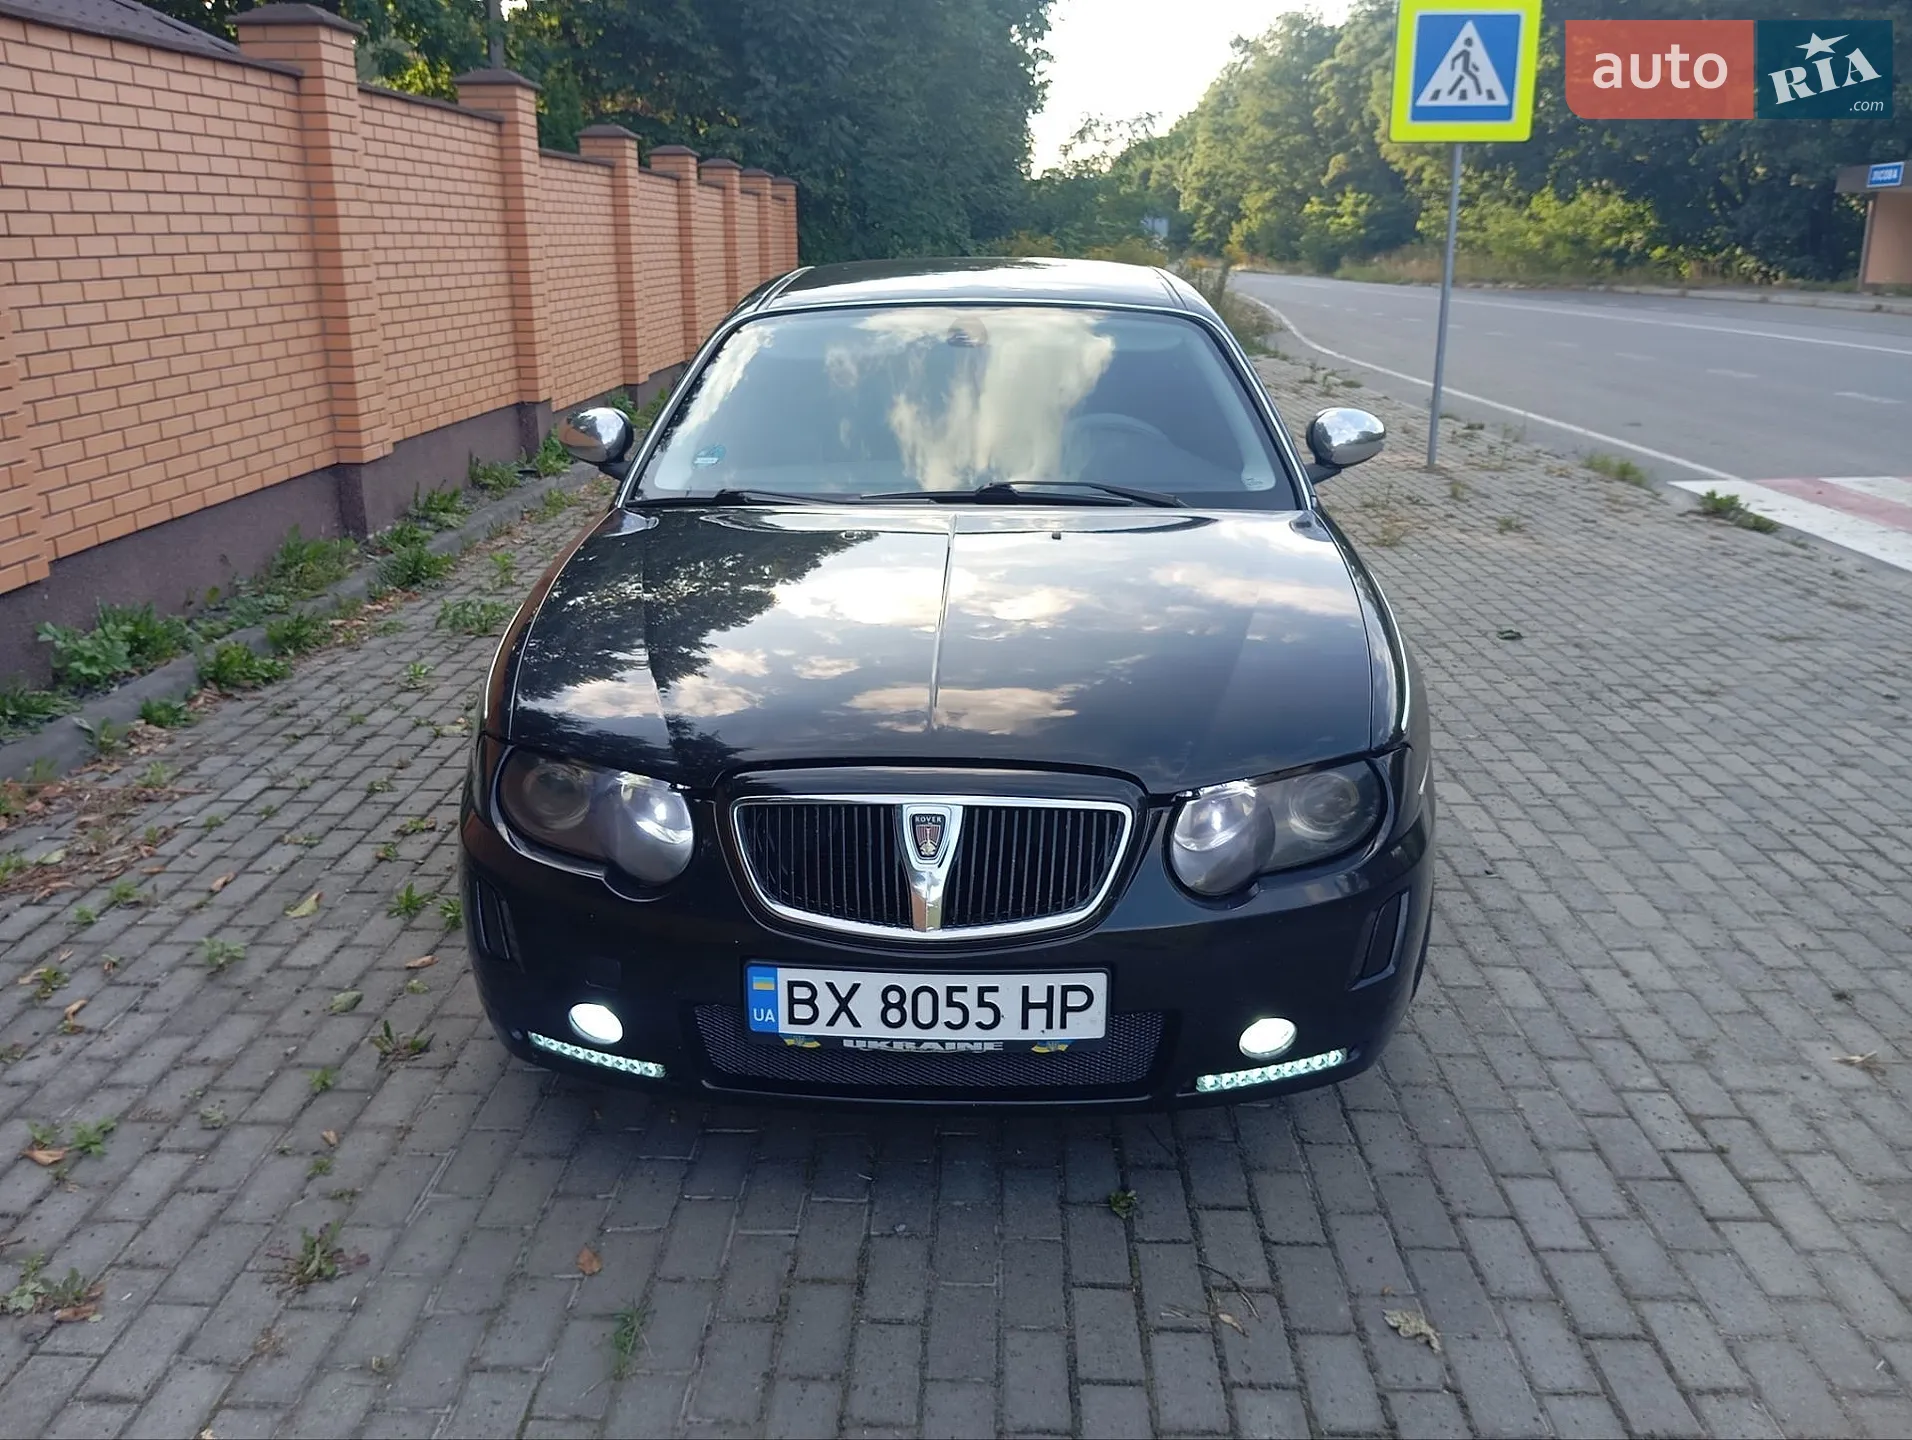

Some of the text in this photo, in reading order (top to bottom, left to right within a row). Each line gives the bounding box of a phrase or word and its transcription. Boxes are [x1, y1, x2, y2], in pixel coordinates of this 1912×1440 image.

[786, 980, 1095, 1031] BX 8055 HP
[753, 1009, 776, 1023] UA
[842, 1039, 1004, 1051] UKRAINE
